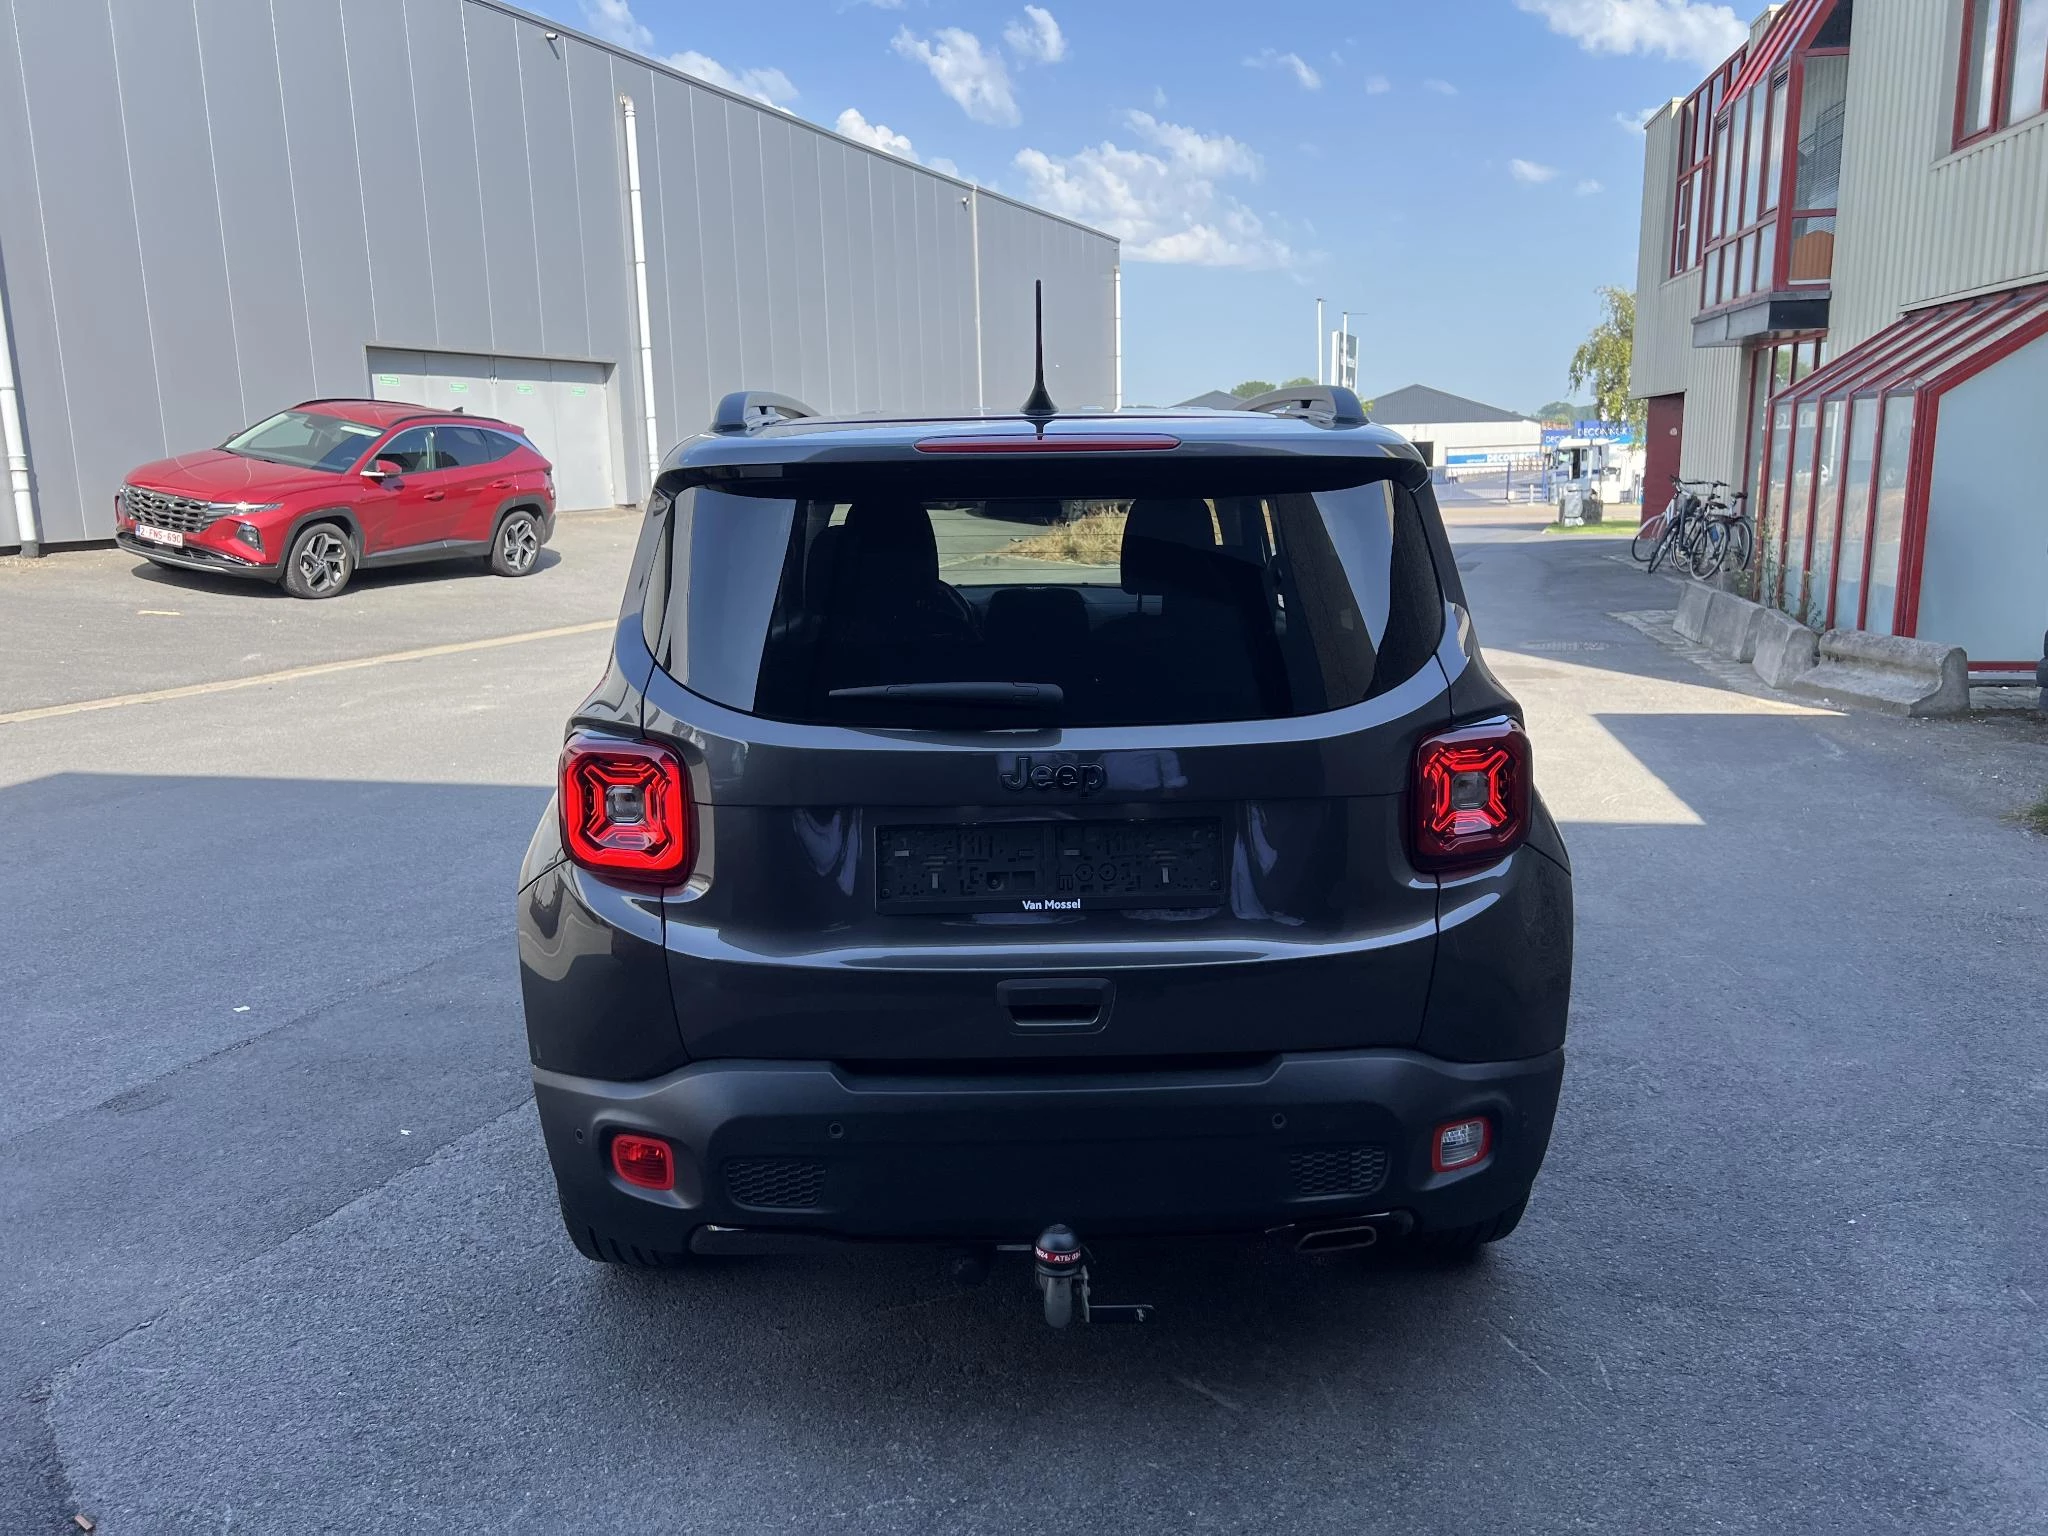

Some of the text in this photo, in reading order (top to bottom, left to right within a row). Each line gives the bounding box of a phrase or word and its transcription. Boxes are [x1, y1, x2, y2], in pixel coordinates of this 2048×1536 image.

[1000, 755, 1107, 798] Jeep
[1022, 898, 1081, 910] Van Mossel
